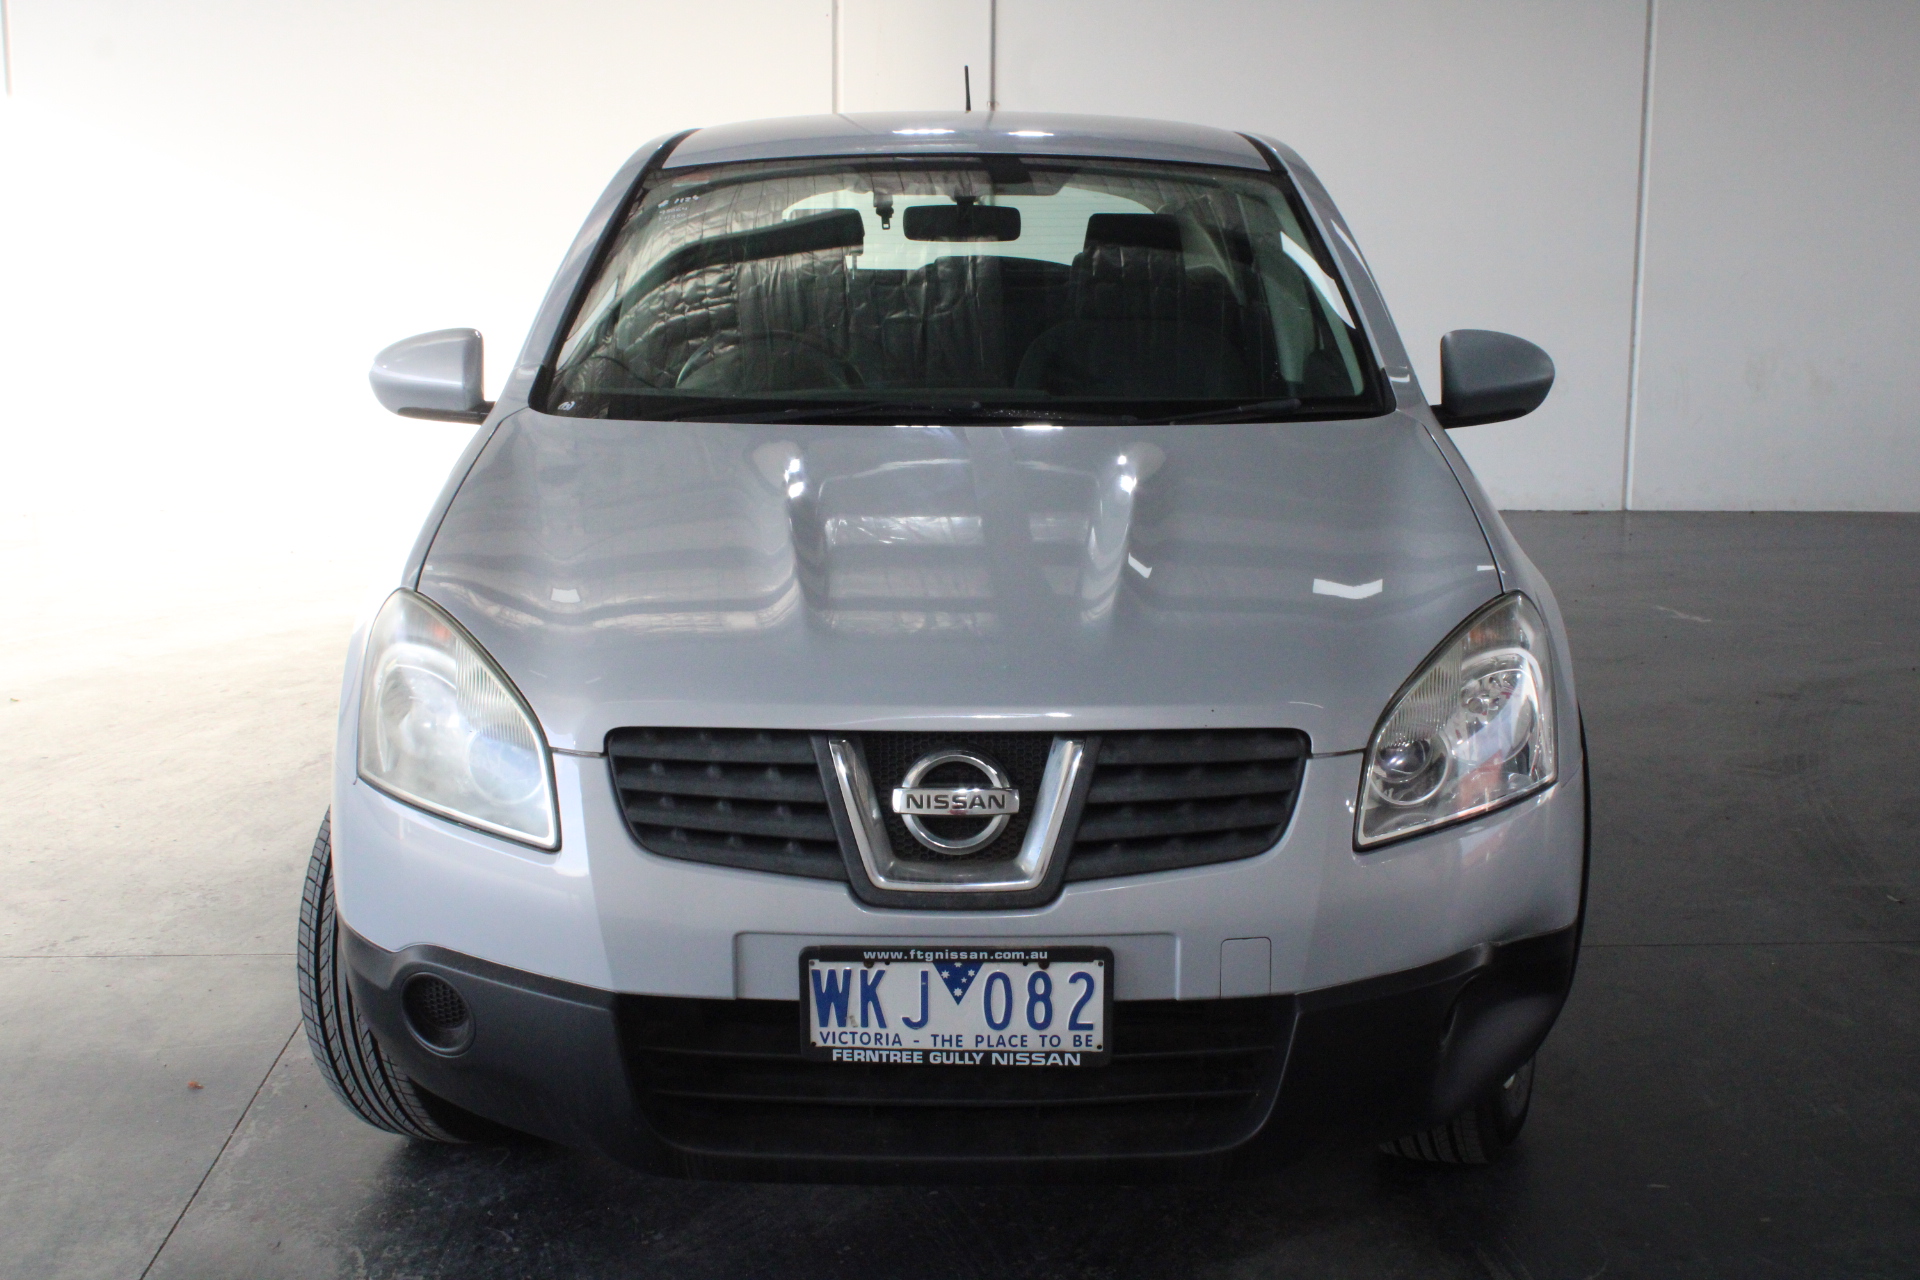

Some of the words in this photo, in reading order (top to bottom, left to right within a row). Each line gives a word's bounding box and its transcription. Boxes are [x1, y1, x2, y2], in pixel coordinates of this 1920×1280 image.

[906, 794, 1005, 810] NISSAN
[863, 949, 1048, 961] www.ftgnissan.com.au
[811, 968, 929, 1029] WKJ
[983, 970, 1096, 1031] 082
[819, 1031, 902, 1047] VICTORIA
[931, 1034, 963, 1047] THE
[975, 1035, 1028, 1048] PLACE
[1039, 1035, 1061, 1048] TO
[1073, 1035, 1093, 1048] BE
[832, 1048, 923, 1064] FERNTREE
[929, 1051, 982, 1065] GULLY
[992, 1052, 1081, 1066] NISSAN
